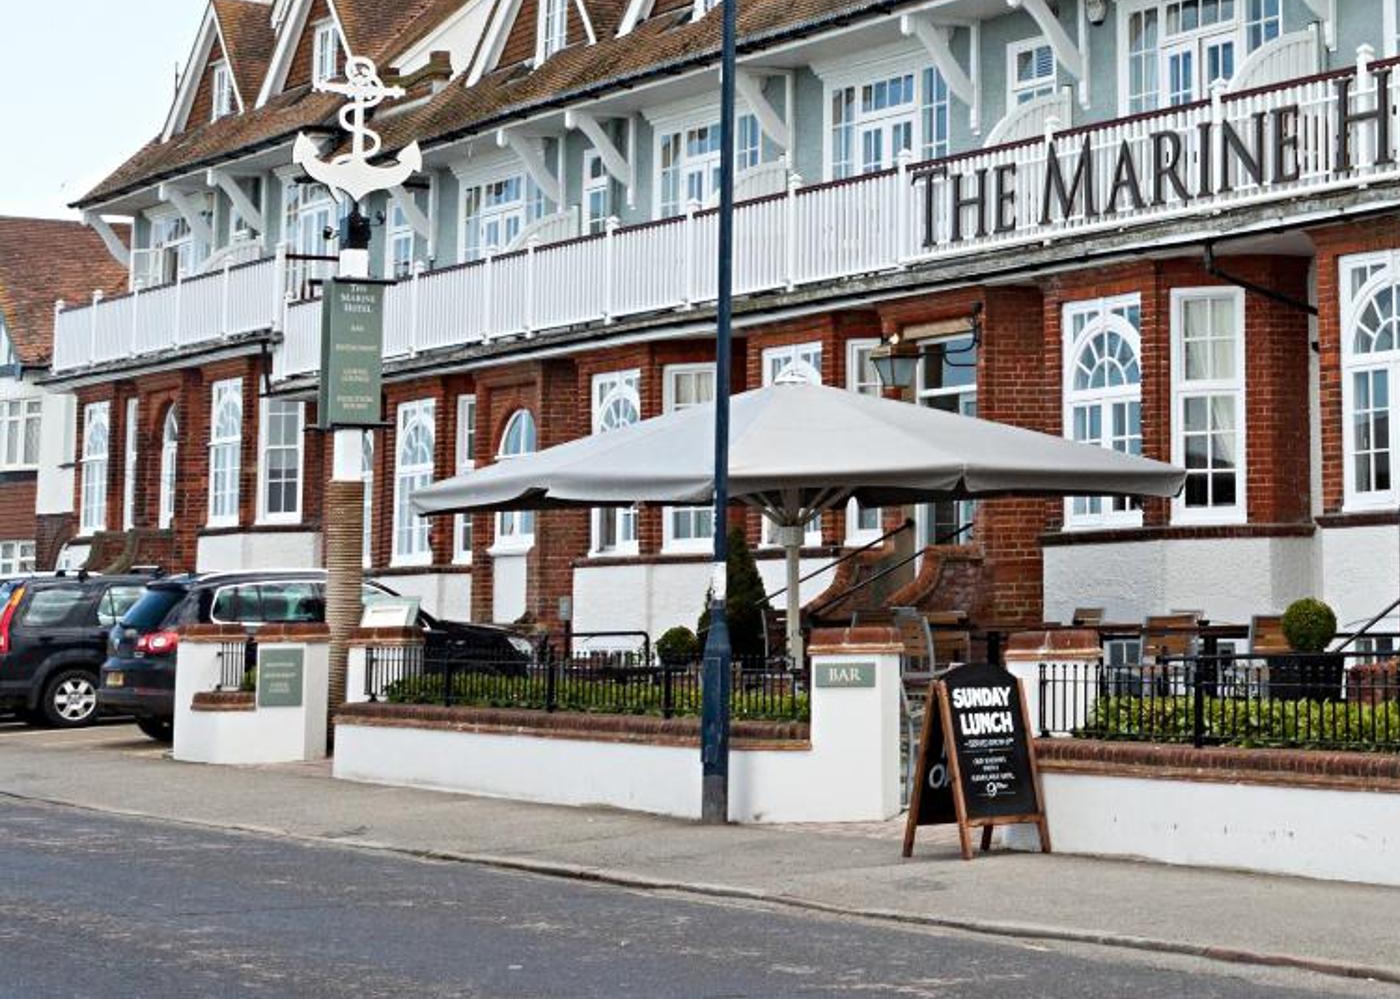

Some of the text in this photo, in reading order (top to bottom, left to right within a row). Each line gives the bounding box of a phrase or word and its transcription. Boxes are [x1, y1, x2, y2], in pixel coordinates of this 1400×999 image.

[911, 162, 1017, 247] THE
[1039, 104, 1300, 226] MARINE
[829, 667, 862, 681] BAR
[952, 686, 1011, 708] SUNDAY
[960, 711, 1014, 736] LUNCH
